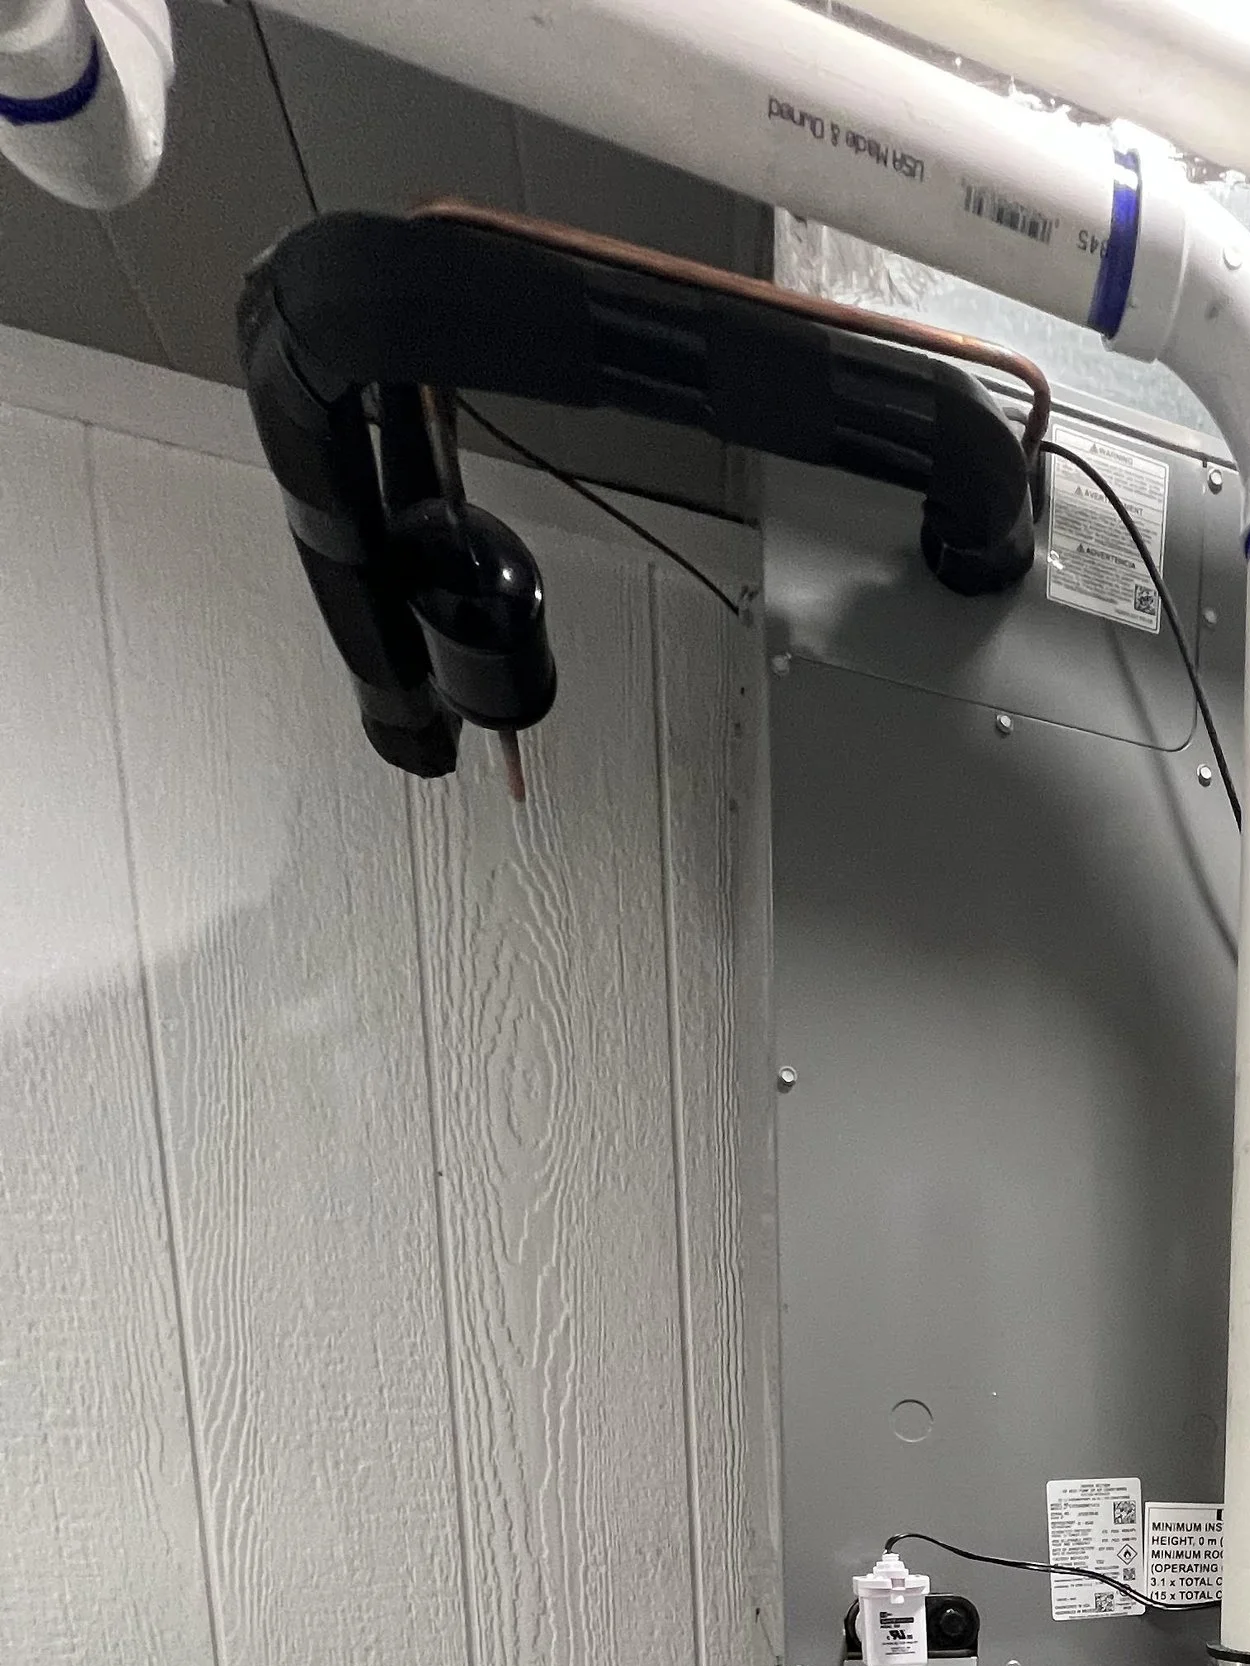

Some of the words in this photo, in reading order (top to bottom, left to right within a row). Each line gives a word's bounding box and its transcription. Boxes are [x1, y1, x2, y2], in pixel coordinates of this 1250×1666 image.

[768, 95, 825, 139] Owned
[830, 122, 841, 147] &
[845, 130, 889, 168] Made
[892, 150, 925, 183] USA
[1151, 1522, 1202, 1532] MINIMUM
[1205, 1522, 1223, 1532] INS
[1151, 1536, 1195, 1547] HEIGHT,
[1198, 1536, 1205, 1546] 0
[1207, 1538, 1217, 1546] m
[1151, 1549, 1201, 1560] MINIMUM
[1151, 1563, 1218, 1575] (OPERATING
[1150, 1577, 1165, 1587] 3.1
[1179, 1577, 1213, 1587] TOTAL
[1150, 1591, 1167, 1601] (15
[1179, 1590, 1213, 1600] TOTAL
